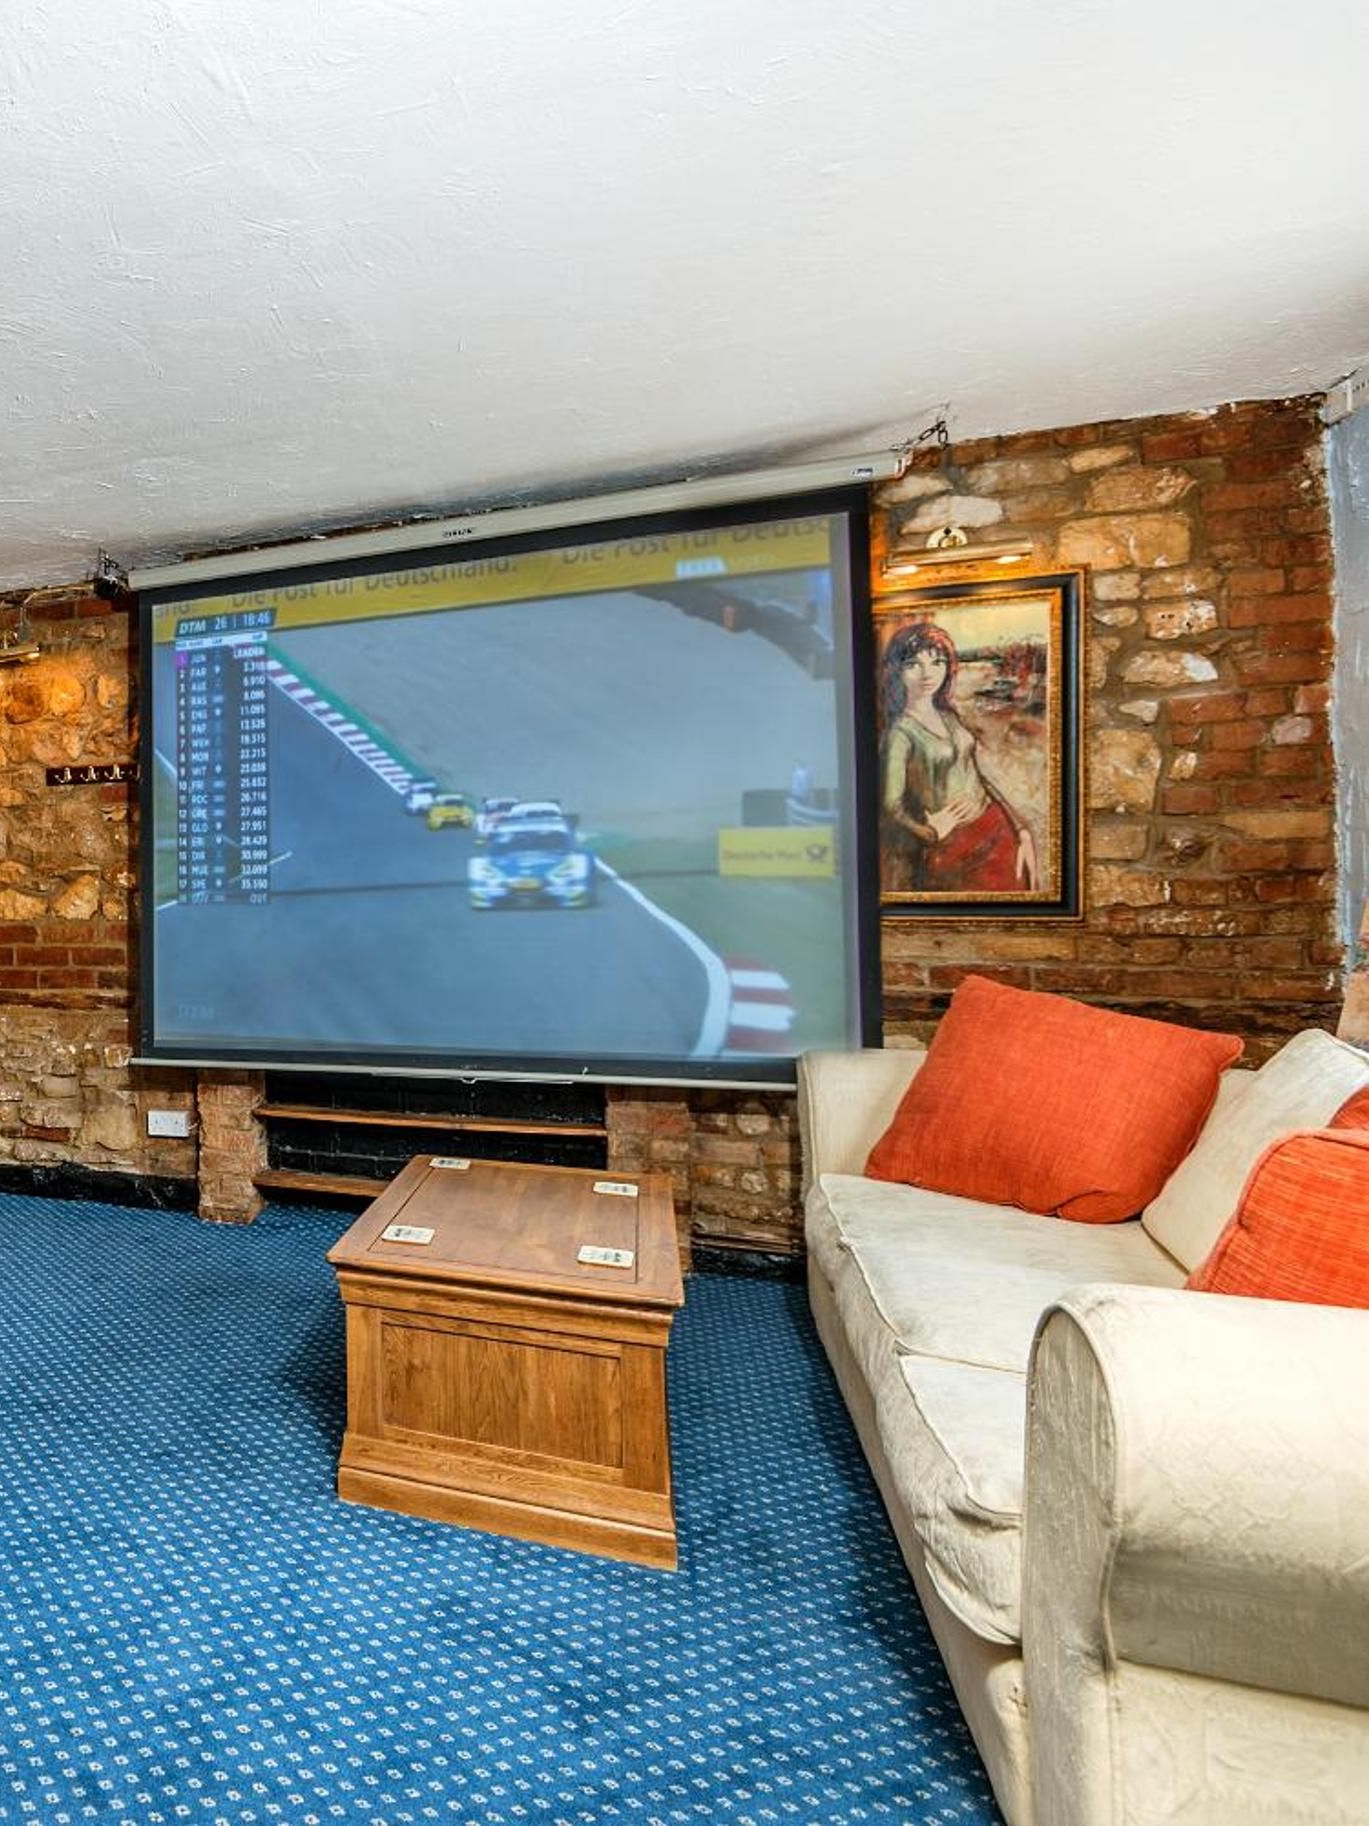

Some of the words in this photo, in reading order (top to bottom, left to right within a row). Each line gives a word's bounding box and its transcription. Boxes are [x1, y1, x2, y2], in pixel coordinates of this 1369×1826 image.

[179, 619, 207, 635] DTM
[215, 616, 228, 631] 26
[243, 611, 271, 627] 18:46
[233, 647, 265, 659] LEADER
